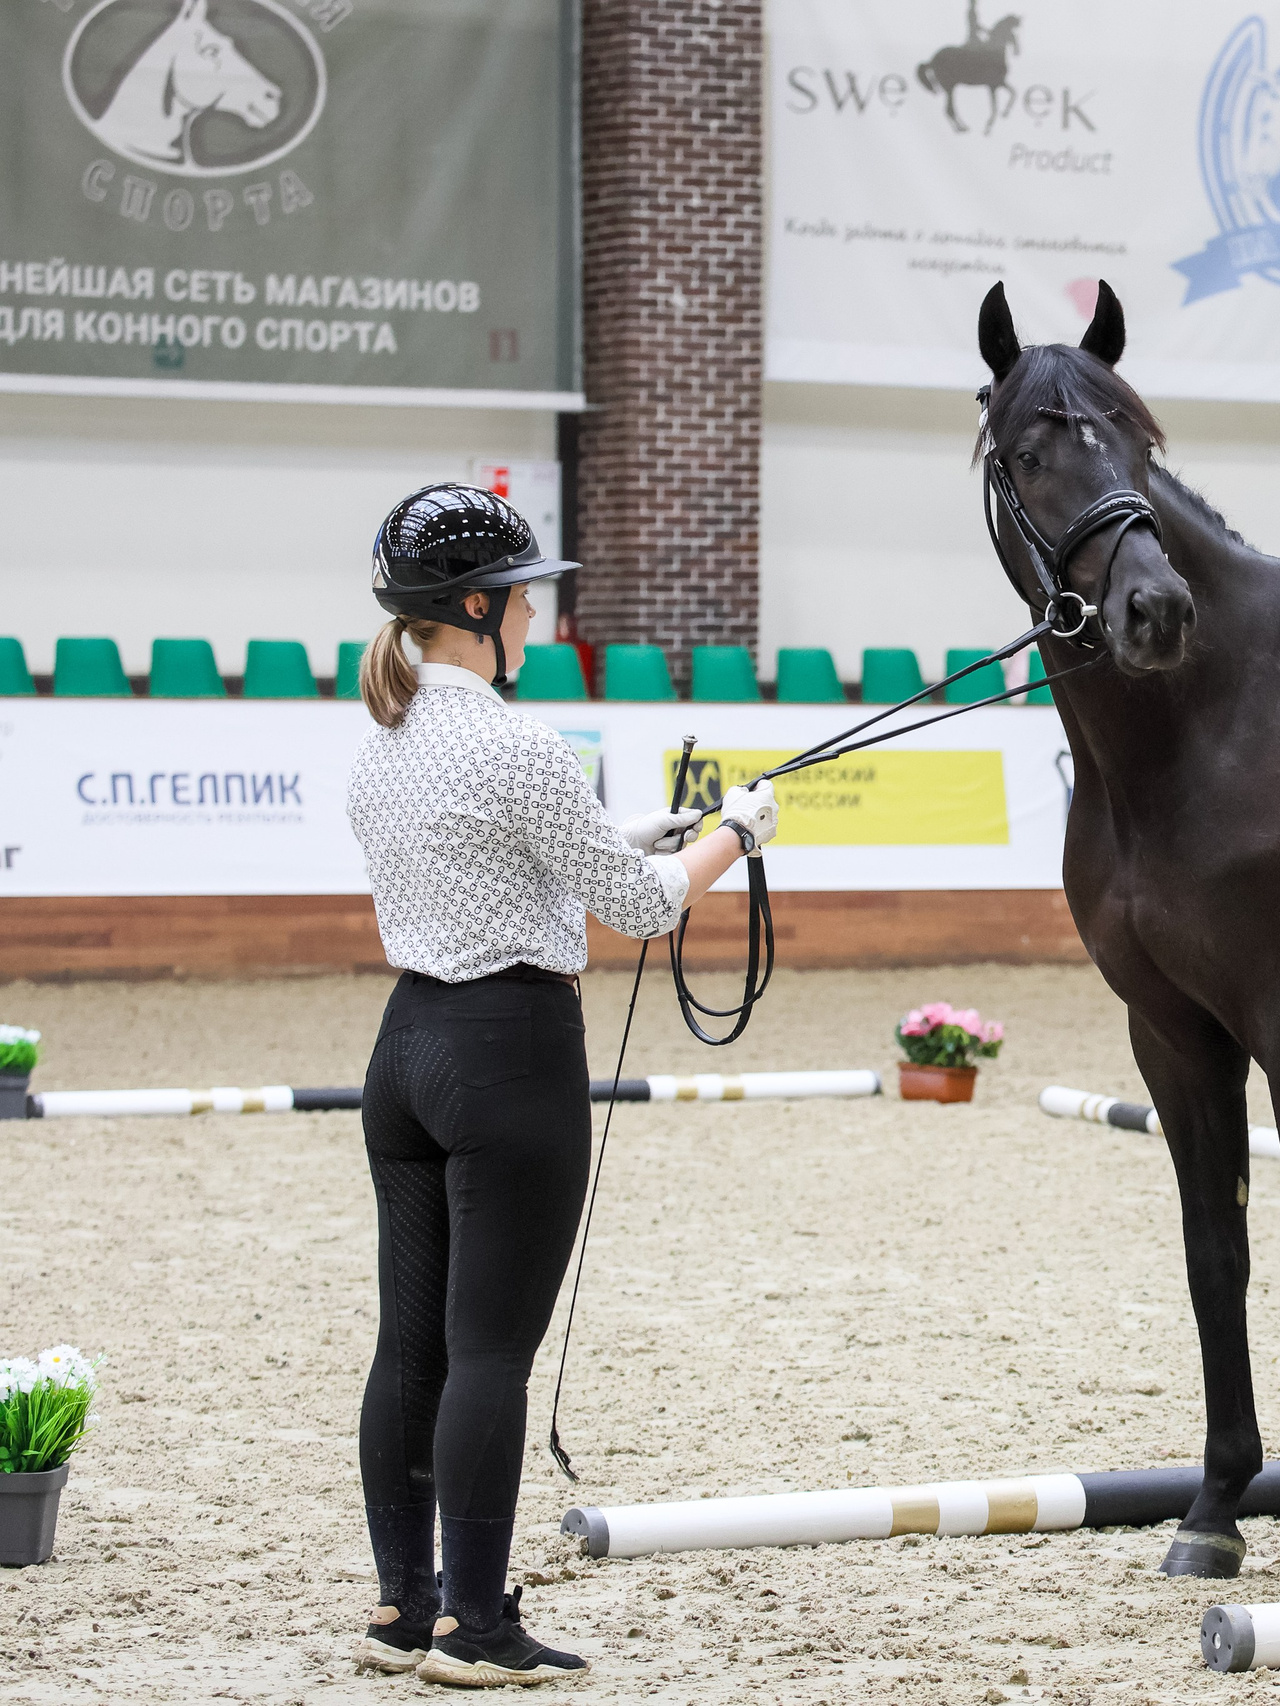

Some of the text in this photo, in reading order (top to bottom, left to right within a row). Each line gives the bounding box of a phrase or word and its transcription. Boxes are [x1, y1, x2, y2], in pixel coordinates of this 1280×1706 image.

[1007, 142, 1115, 175] Product
[81, 158, 316, 232] СПОРТА
[0, 256, 481, 314] НЕЙШАЯ СЕТЬ МАГАЗИНОВ
[0, 305, 397, 356] ДЛЯ КОННОГО СПОРТА
